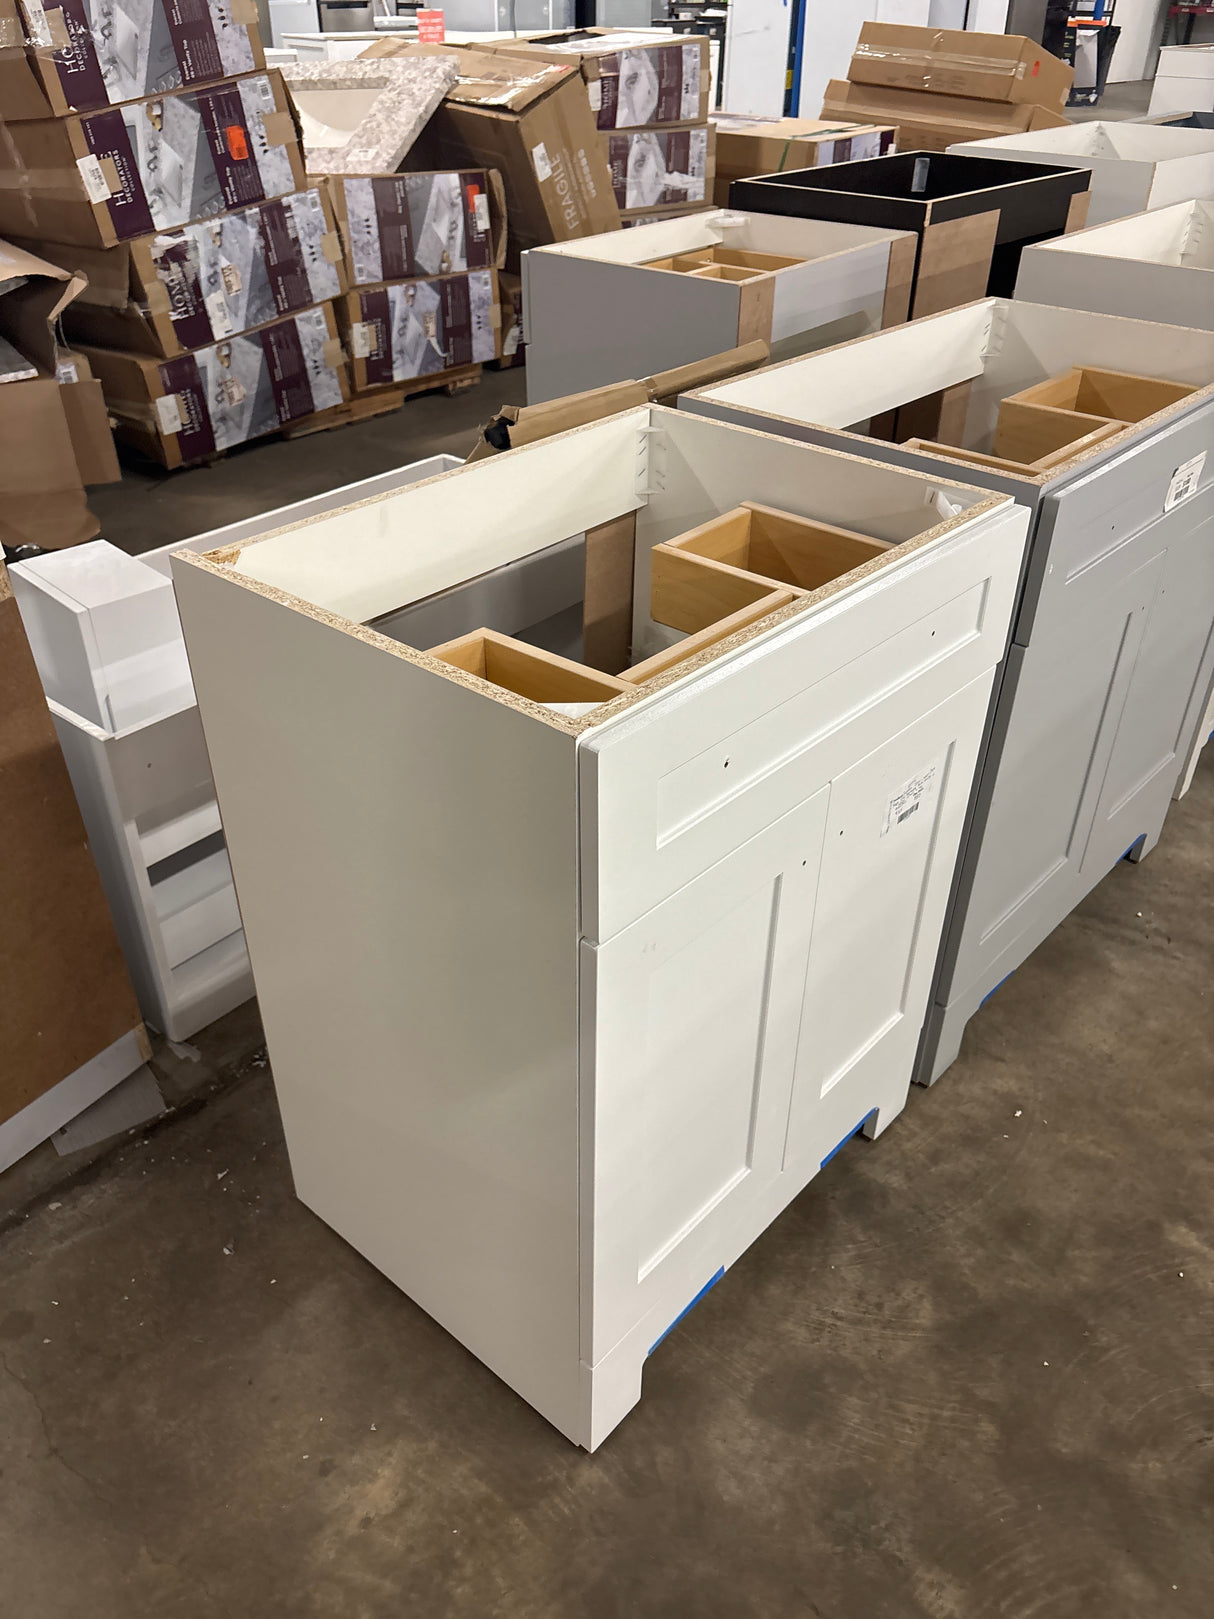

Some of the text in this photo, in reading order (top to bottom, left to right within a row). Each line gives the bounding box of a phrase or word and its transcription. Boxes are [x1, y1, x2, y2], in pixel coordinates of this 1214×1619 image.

[112, 148, 133, 203] DECORATORS
[121, 156, 136, 191] COLLECTION
[552, 153, 579, 230] FRAGILE
